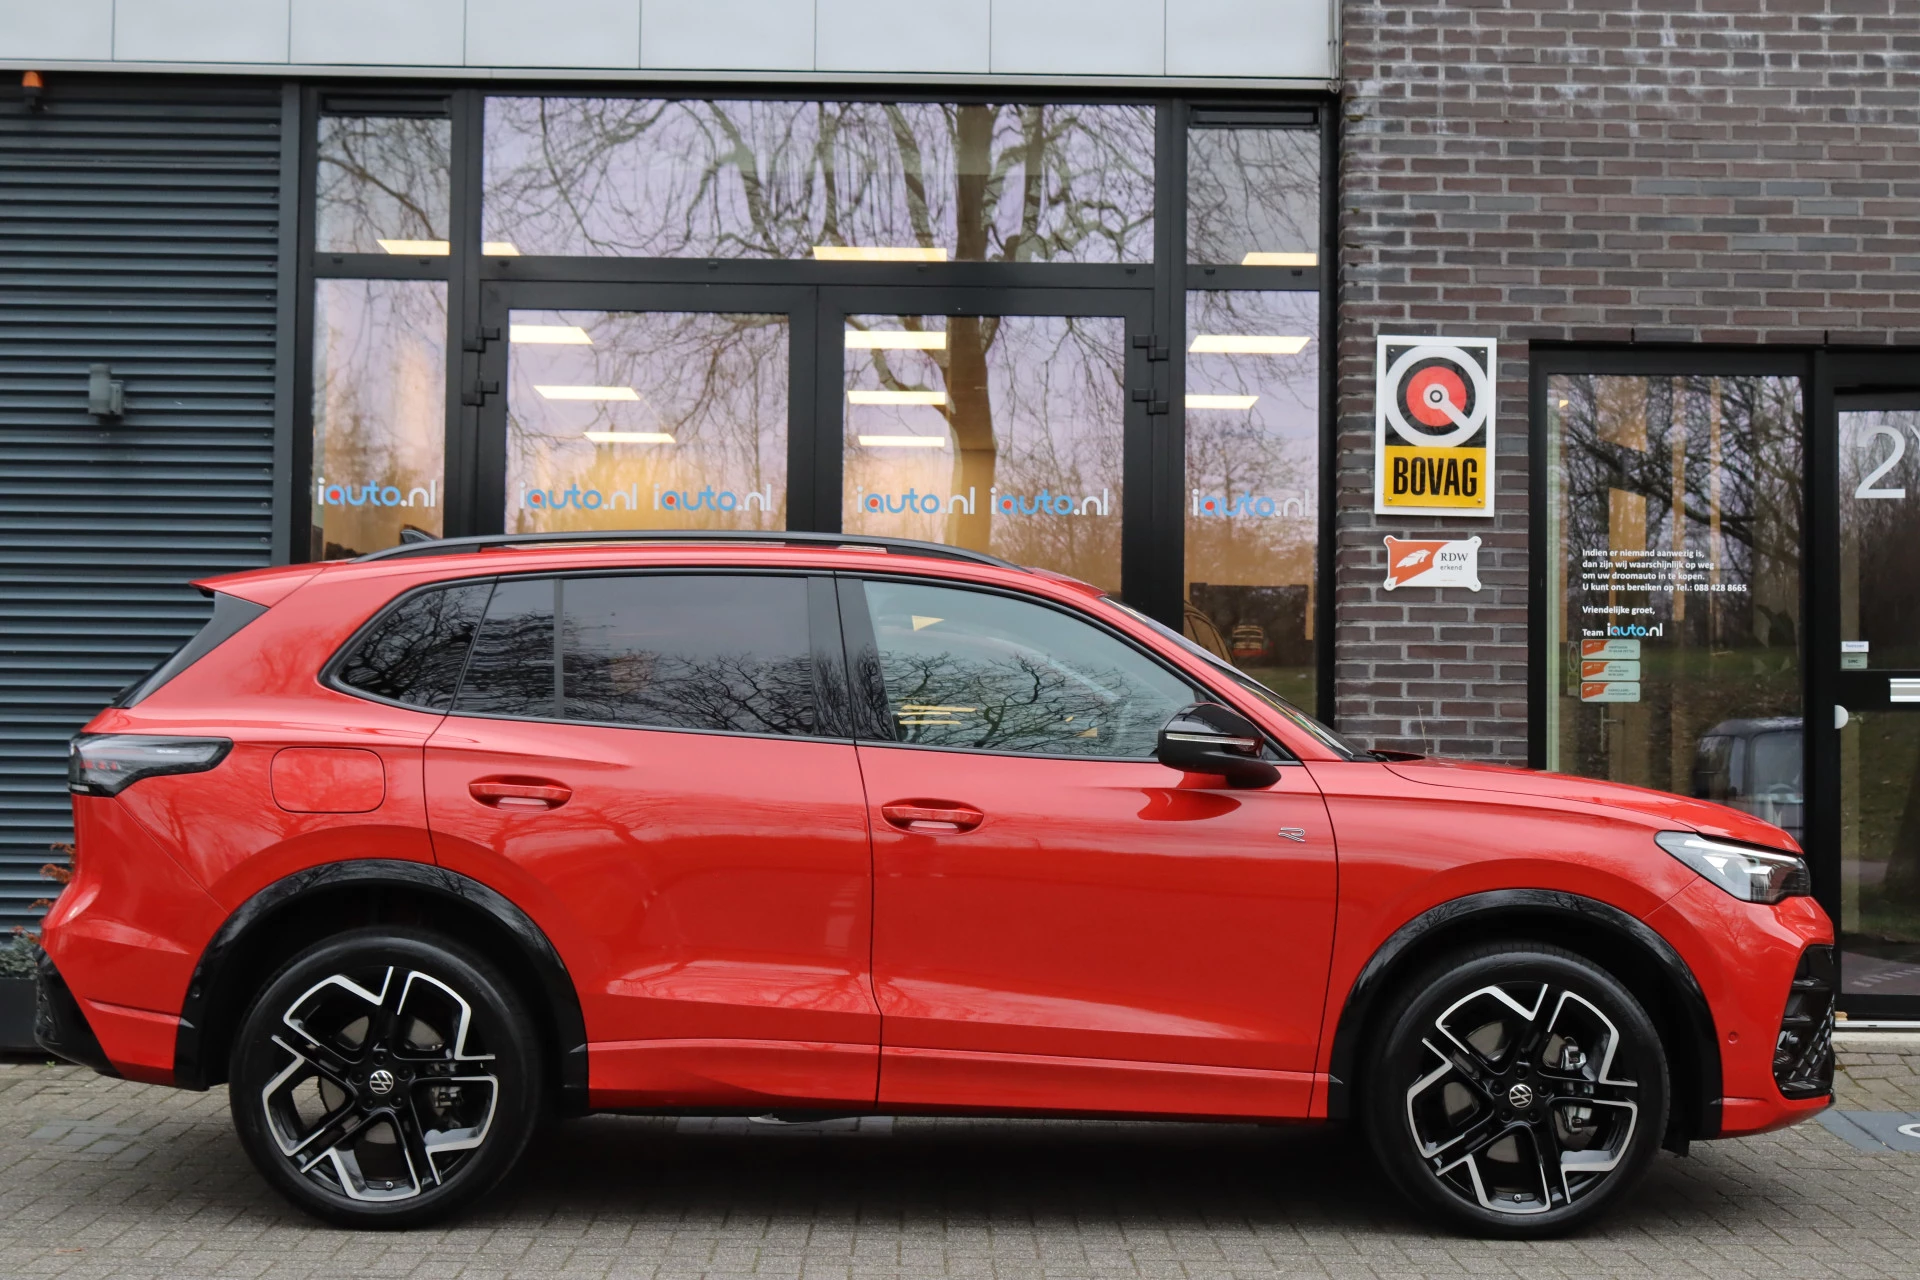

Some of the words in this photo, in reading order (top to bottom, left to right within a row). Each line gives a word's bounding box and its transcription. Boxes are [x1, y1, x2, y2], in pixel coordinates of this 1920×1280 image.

[1392, 456, 1478, 497] BOVAG
[317, 477, 437, 508] iauto.nl
[519, 481, 638, 511] iauto.nl
[653, 483, 772, 512] iauto.nl
[856, 485, 976, 515] iauto.nl
[990, 487, 1109, 516] iauto.nl
[1192, 488, 1310, 518] iauto.nl
[1440, 552, 1468, 561] RDW
[1582, 549, 1608, 557] Indien
[1619, 549, 1655, 557] niemand
[1657, 549, 1694, 558] aanwezig
[1695, 549, 1705, 558] is,
[1582, 560, 1598, 568] dan
[1599, 560, 1613, 570] zijn
[1615, 560, 1628, 570] wij
[1629, 560, 1684, 570] waarschijnlijk
[1685, 562, 1696, 570] op
[1697, 562, 1715, 570] weg
[1611, 572, 1657, 580] droomauto
[1658, 572, 1666, 580] in
[1678, 572, 1705, 581] kopen.
[1582, 583, 1589, 591] U
[1590, 583, 1609, 591] kunt
[1626, 583, 1662, 591] bereiken
[1663, 584, 1674, 593] op
[1676, 583, 1693, 591] Tel.:
[1694, 583, 1709, 592] 088
[1710, 583, 1726, 592] 428
[1727, 584, 1747, 592] 8665
[1582, 605, 1630, 616] Vriendelijke
[1631, 606, 1656, 616] groet,
[1582, 628, 1604, 637] Team
[1607, 622, 1663, 637] iauto.nl
